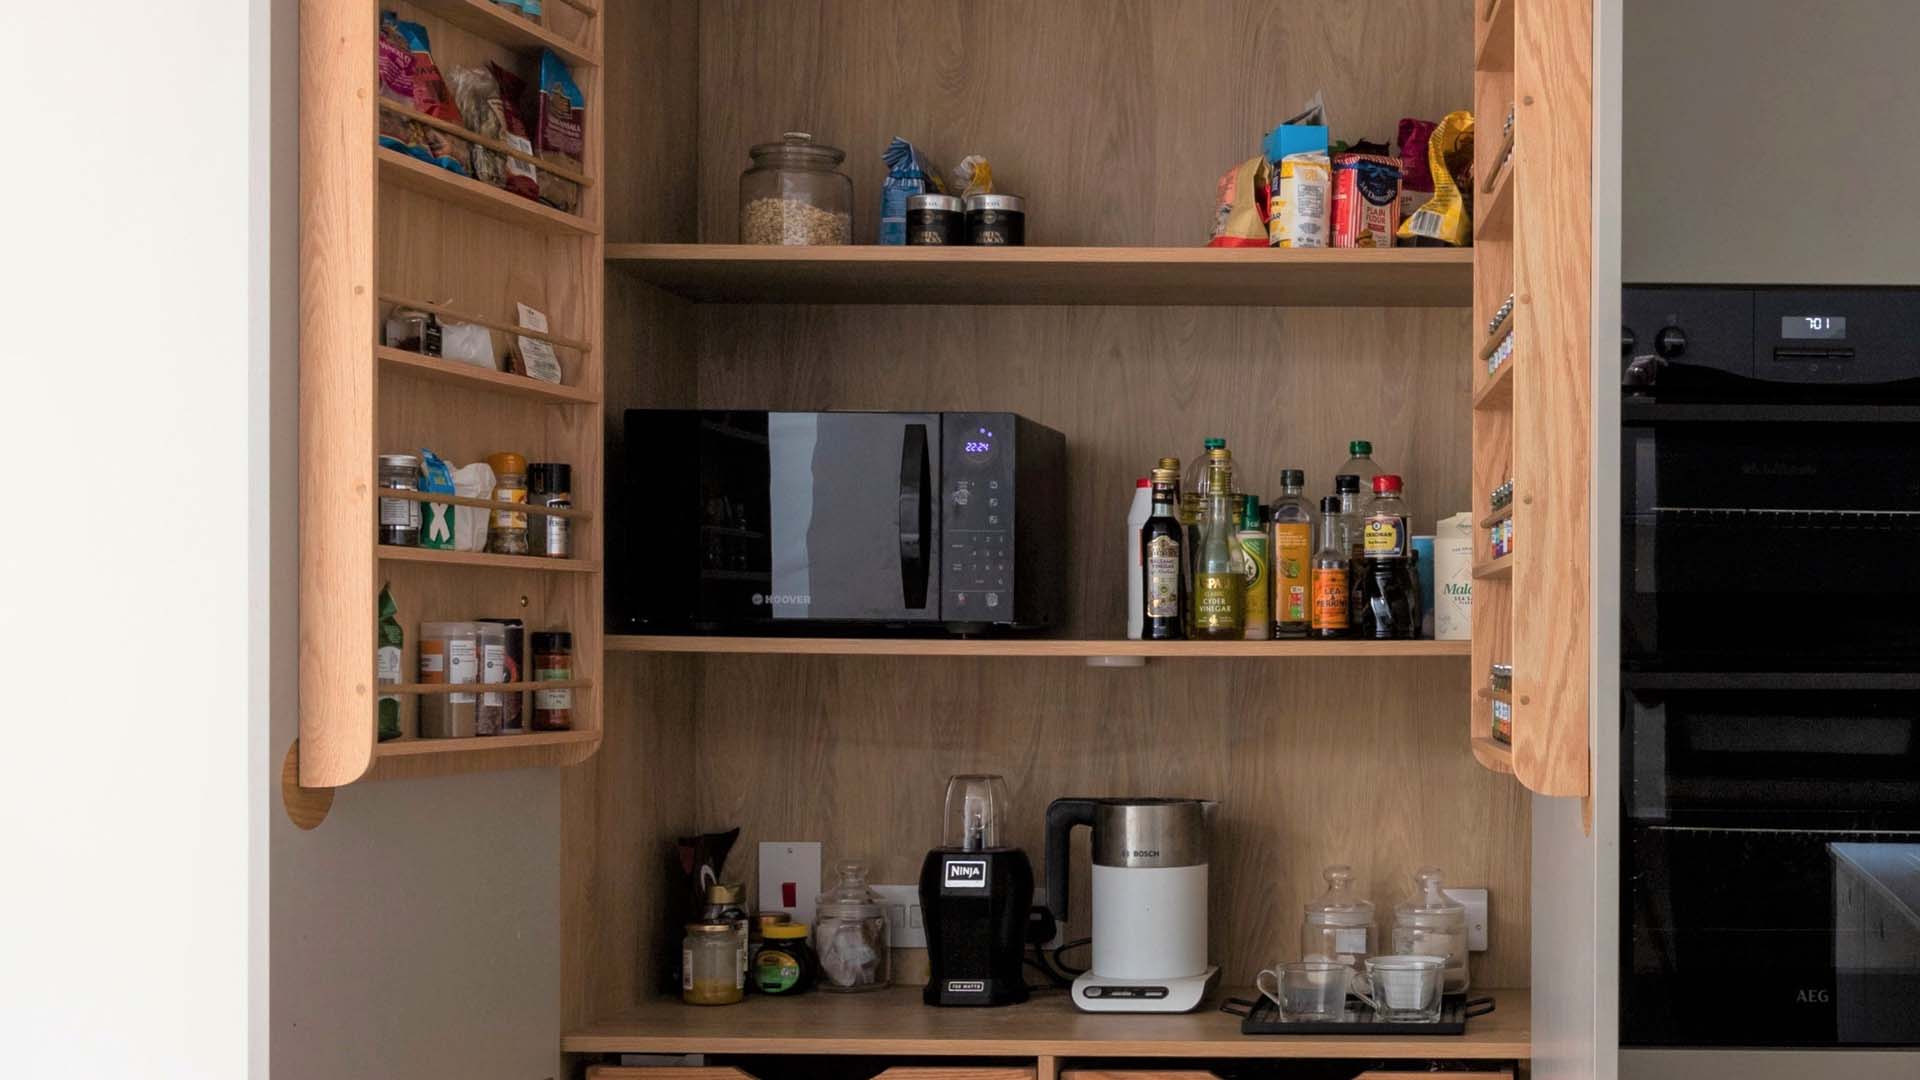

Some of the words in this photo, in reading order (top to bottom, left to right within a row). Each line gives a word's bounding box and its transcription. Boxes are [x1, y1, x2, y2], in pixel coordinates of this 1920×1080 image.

[1367, 206, 1386, 216] PLAIN
[765, 594, 811, 605] HOOVER
[1200, 605, 1232, 613] VINEGAR
[1133, 850, 1160, 858] BOSCH
[1796, 989, 1830, 1003] AEG
